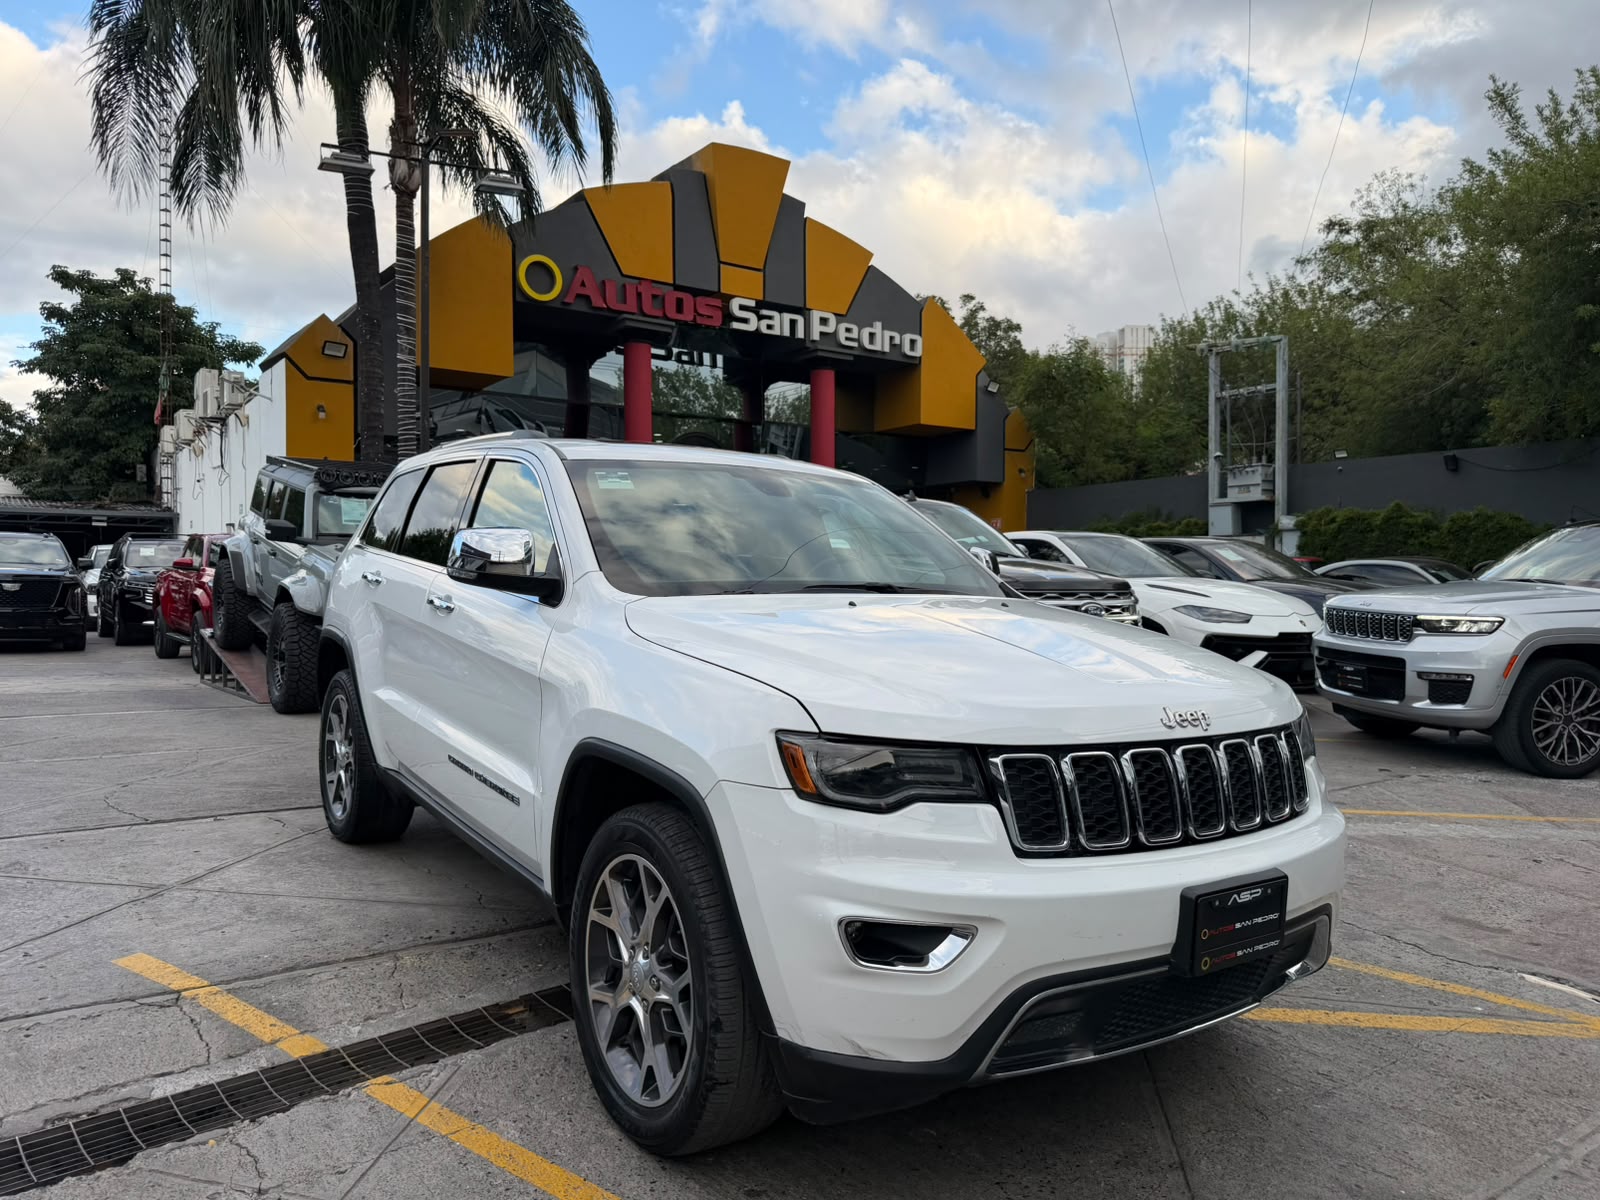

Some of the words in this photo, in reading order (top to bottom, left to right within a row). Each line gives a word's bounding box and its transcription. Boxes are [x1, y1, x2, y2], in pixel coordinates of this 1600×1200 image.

[564, 264, 723, 327] Autos
[1160, 706, 1210, 731] Jeep
[1227, 888, 1262, 905] ASP
[1235, 919, 1252, 929] SAN
[1252, 913, 1279, 924] PEDRO
[1236, 947, 1253, 956] SAN
[1253, 940, 1279, 952] PEDRO
